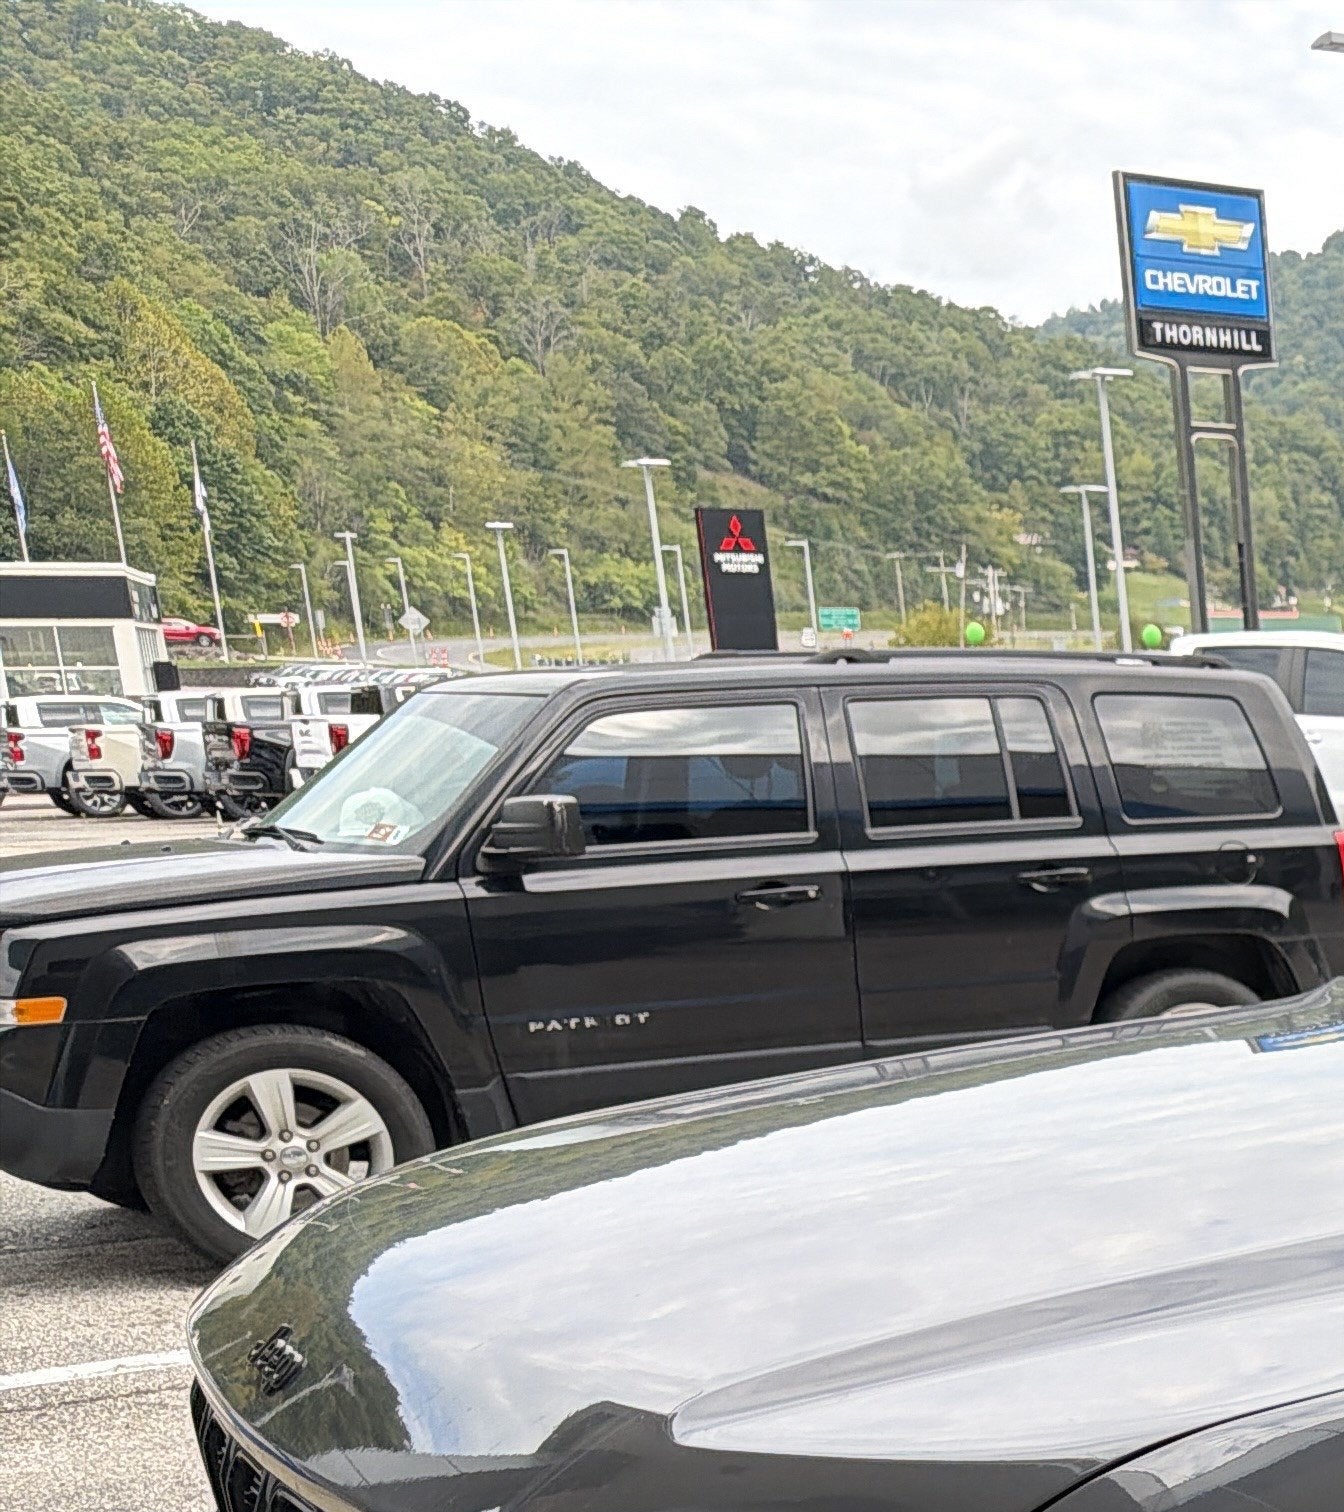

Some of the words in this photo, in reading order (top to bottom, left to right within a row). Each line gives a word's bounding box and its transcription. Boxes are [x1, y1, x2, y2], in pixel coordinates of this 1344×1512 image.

[1144, 269, 1260, 300] CHEVROLET
[1151, 322, 1263, 352] THORNHILL
[528, 1011, 650, 1033] PATROT
